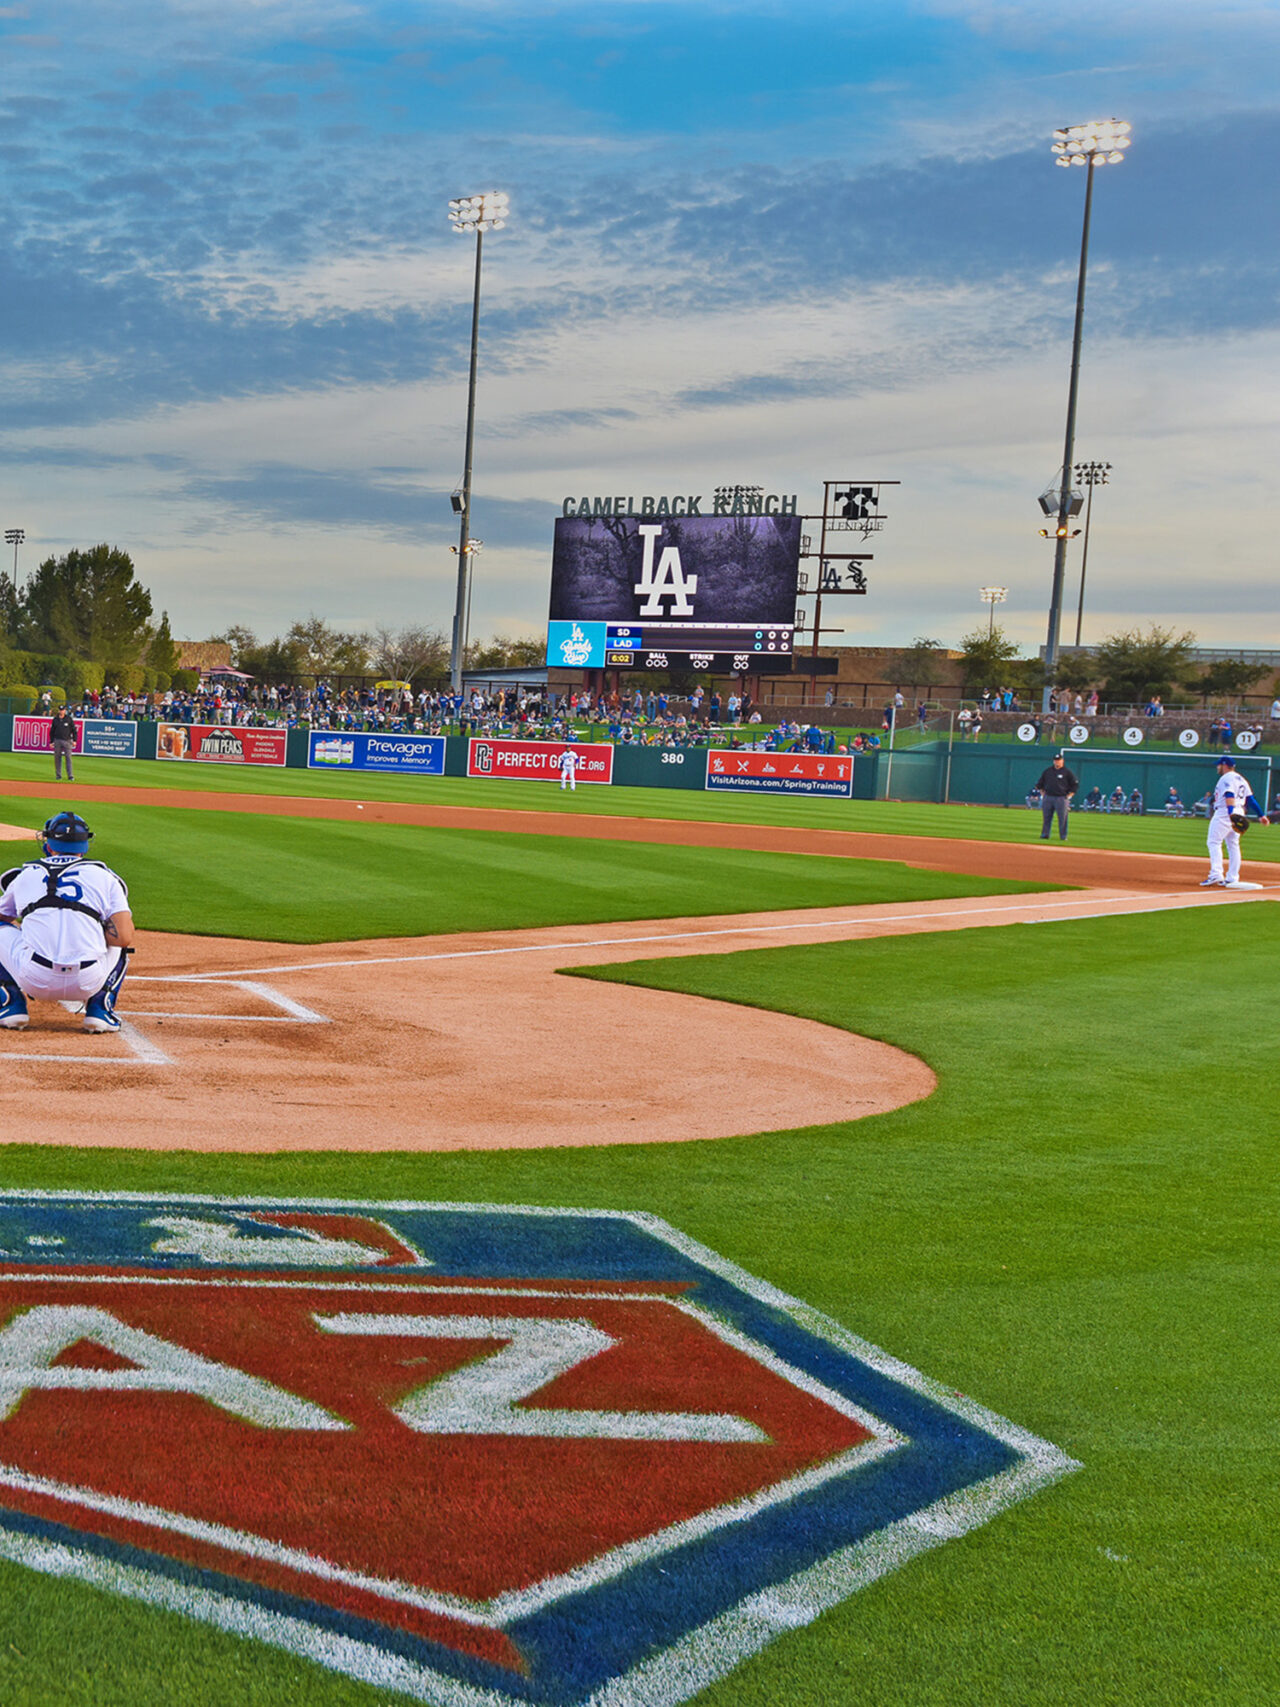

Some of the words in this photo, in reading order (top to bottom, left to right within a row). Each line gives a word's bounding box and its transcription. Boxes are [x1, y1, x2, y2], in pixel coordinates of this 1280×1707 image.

[562, 496, 702, 517] CAMELBACK
[713, 495, 798, 517] RANCH
[634, 525, 698, 616] LA
[617, 628, 631, 637] SD
[613, 640, 633, 648] LAD
[611, 654, 630, 663] 6:02
[1023, 727, 1030, 735] 2
[1076, 729, 1083, 737] 3
[1128, 731, 1136, 739] 4
[1185, 733, 1193, 741] 9
[1241, 735, 1252, 743] 11
[200, 737, 220, 754] TWIN
[220, 738, 242, 755] PEAKS
[367, 738, 432, 757] Prevagen
[366, 754, 399, 764] Improves
[401, 756, 432, 766] Memory
[497, 752, 548, 769] PERFECT
[661, 753, 685, 764] 380
[711, 775, 848, 793] VisitArizona.com/SpringTraining
[42, 871, 84, 903] 5
